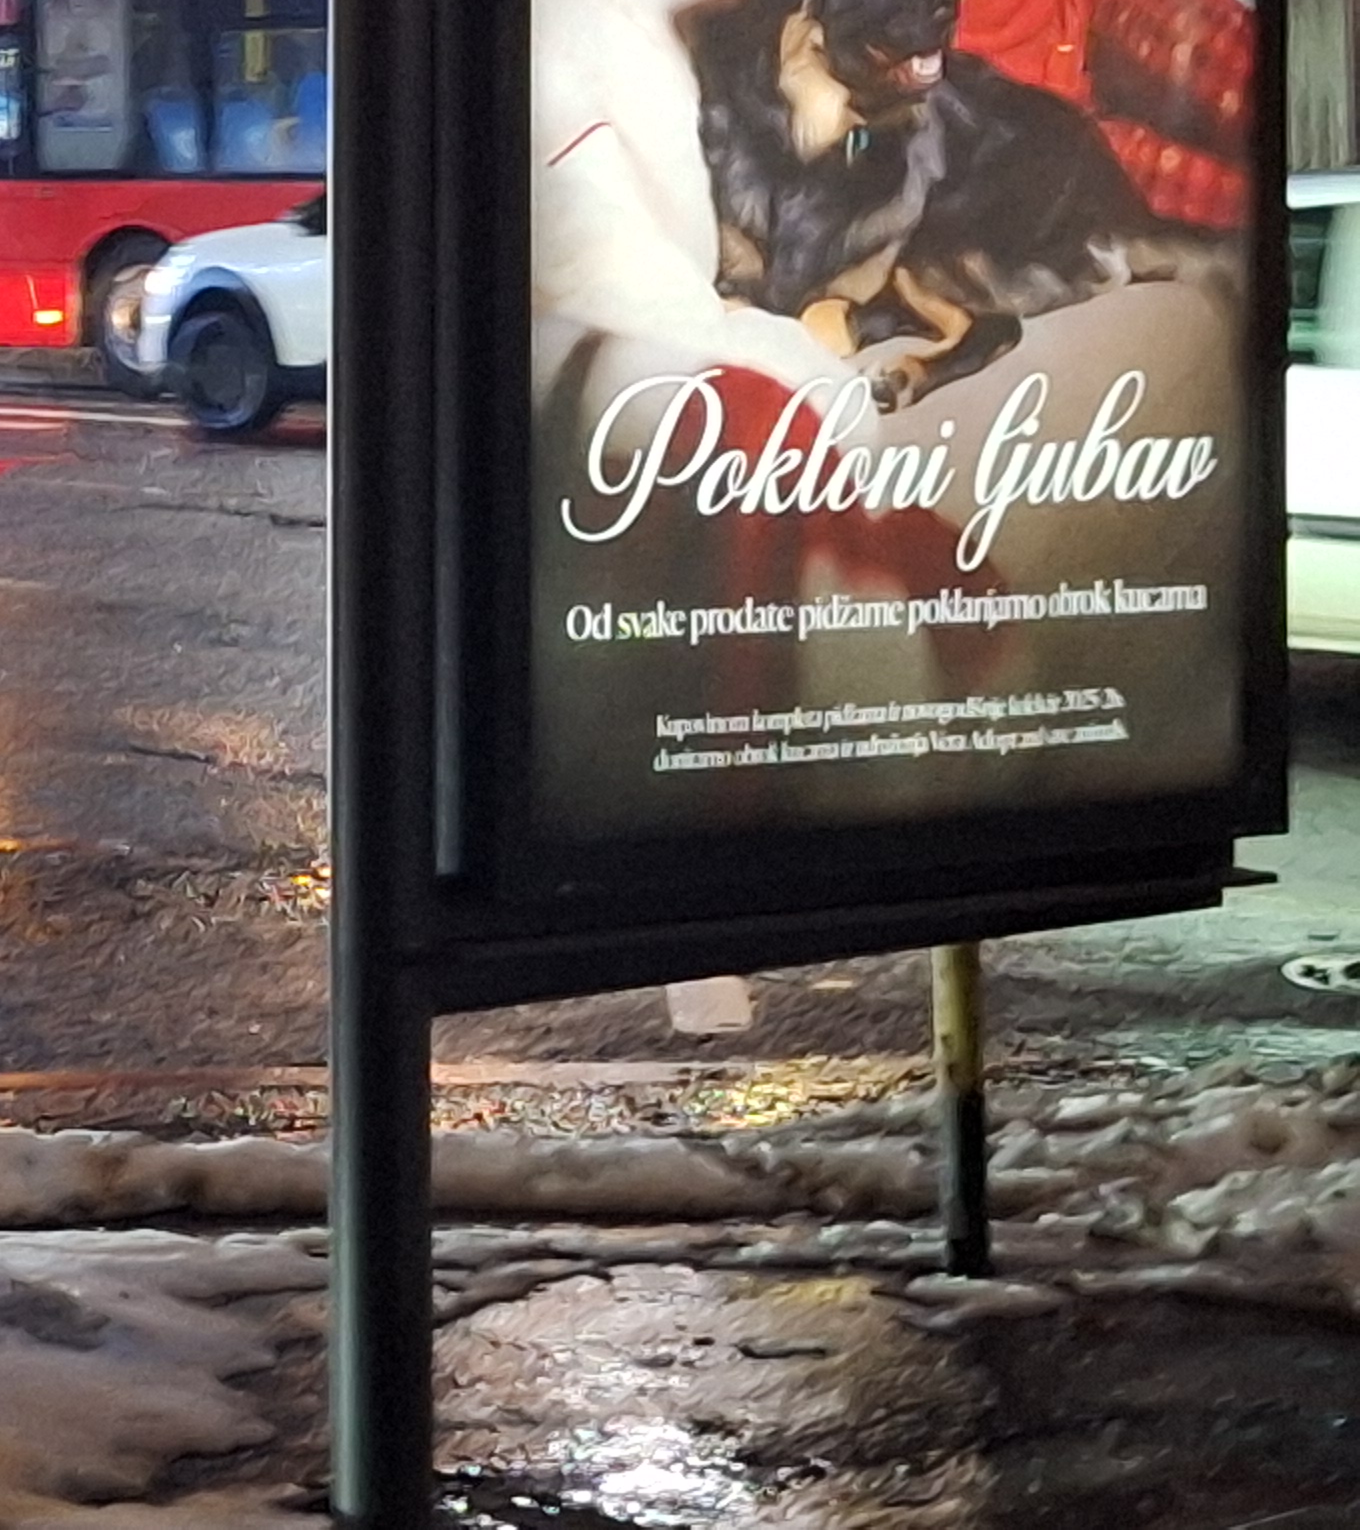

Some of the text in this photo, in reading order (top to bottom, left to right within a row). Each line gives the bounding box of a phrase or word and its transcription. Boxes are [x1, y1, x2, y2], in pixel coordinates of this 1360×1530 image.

[561, 368, 1219, 571] Pokloni ljubav
[566, 602, 612, 641] Od
[616, 600, 687, 640] svake
[690, 596, 794, 646] prodate
[799, 594, 903, 641] pidžame
[1048, 581, 1112, 617] obrok
